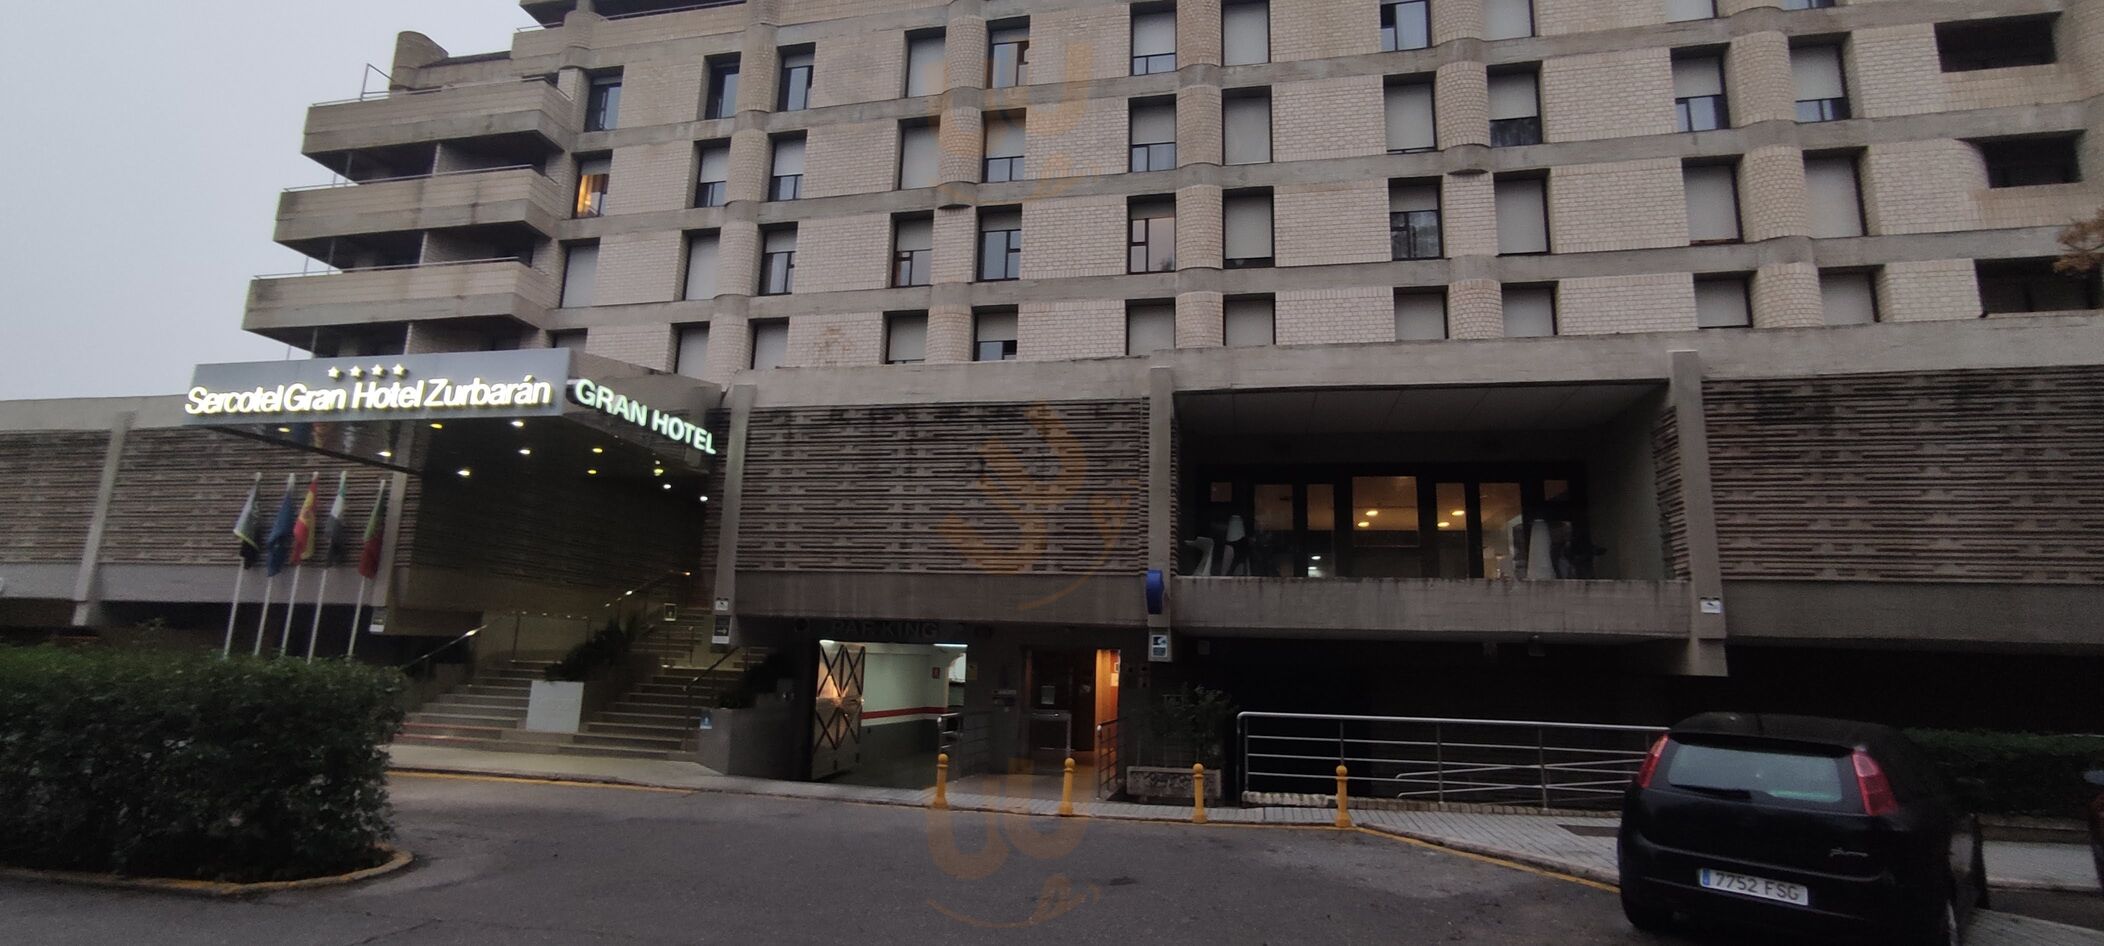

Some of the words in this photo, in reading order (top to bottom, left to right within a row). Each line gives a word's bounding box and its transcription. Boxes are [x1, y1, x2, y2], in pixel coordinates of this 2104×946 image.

[185, 384, 285, 415] Sercotel
[285, 382, 347, 412] Gran
[351, 378, 425, 409] Hotel
[423, 374, 553, 408] Zurbarán
[575, 378, 648, 428] GRAN
[651, 408, 718, 456] HOTEL
[1715, 872, 1758, 894] 7752
[1763, 880, 1799, 901] FSG
